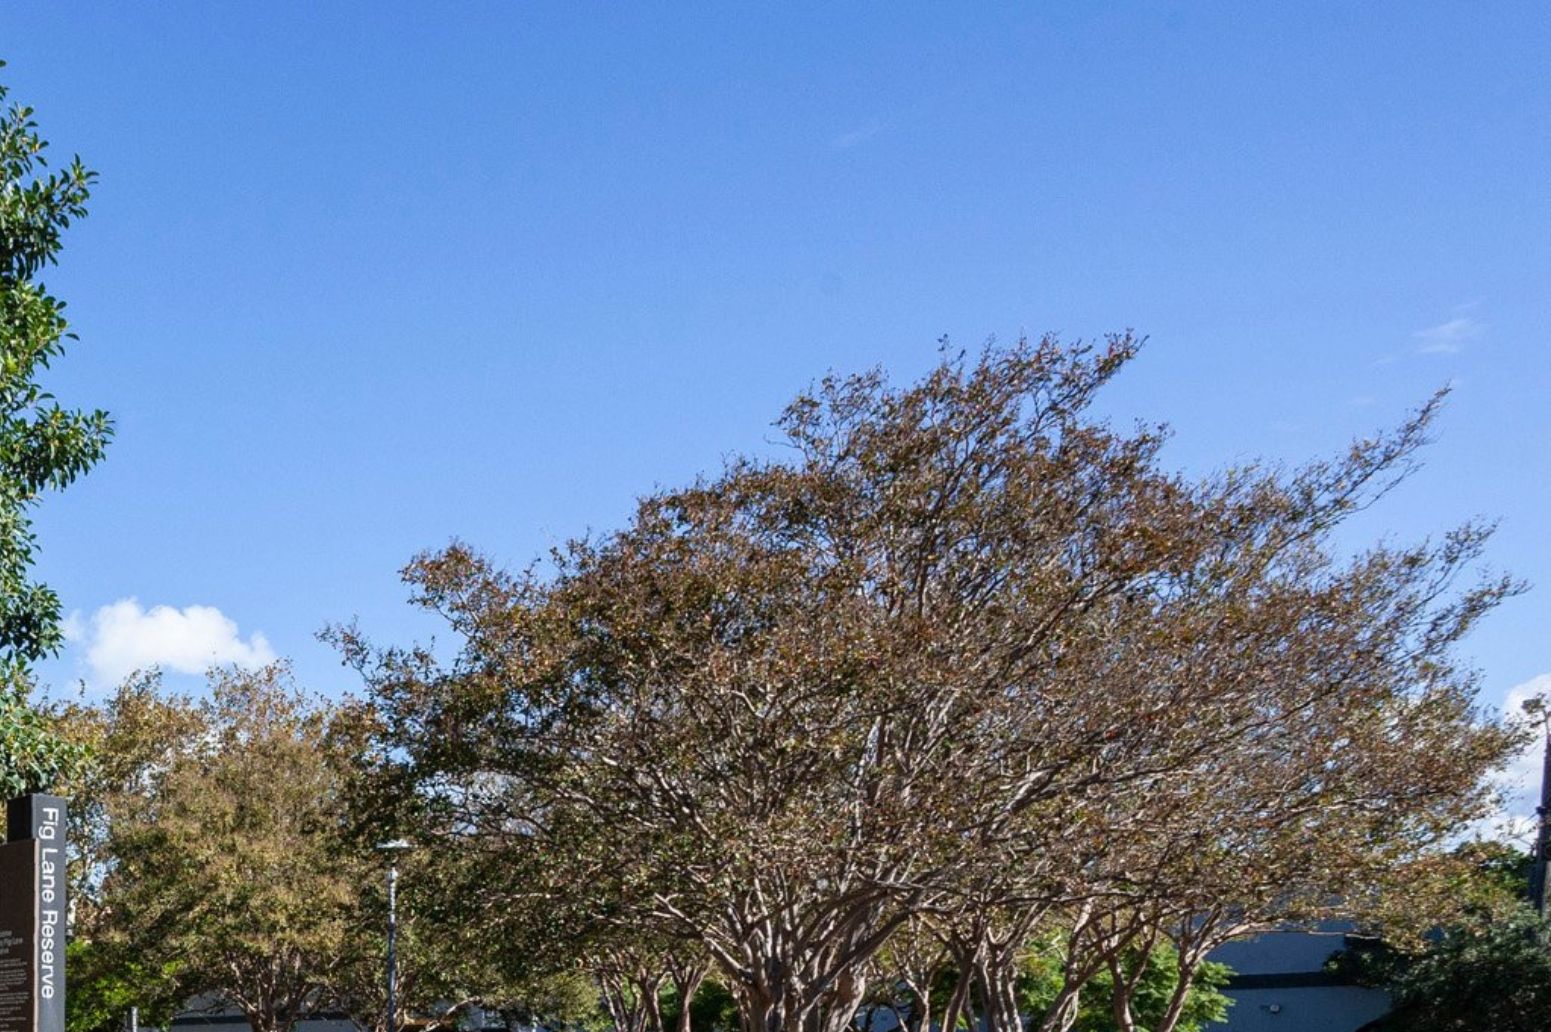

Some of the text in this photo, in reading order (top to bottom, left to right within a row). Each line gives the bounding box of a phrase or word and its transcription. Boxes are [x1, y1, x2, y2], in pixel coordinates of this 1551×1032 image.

[38, 807, 60, 999] Fig Lane Reserve
